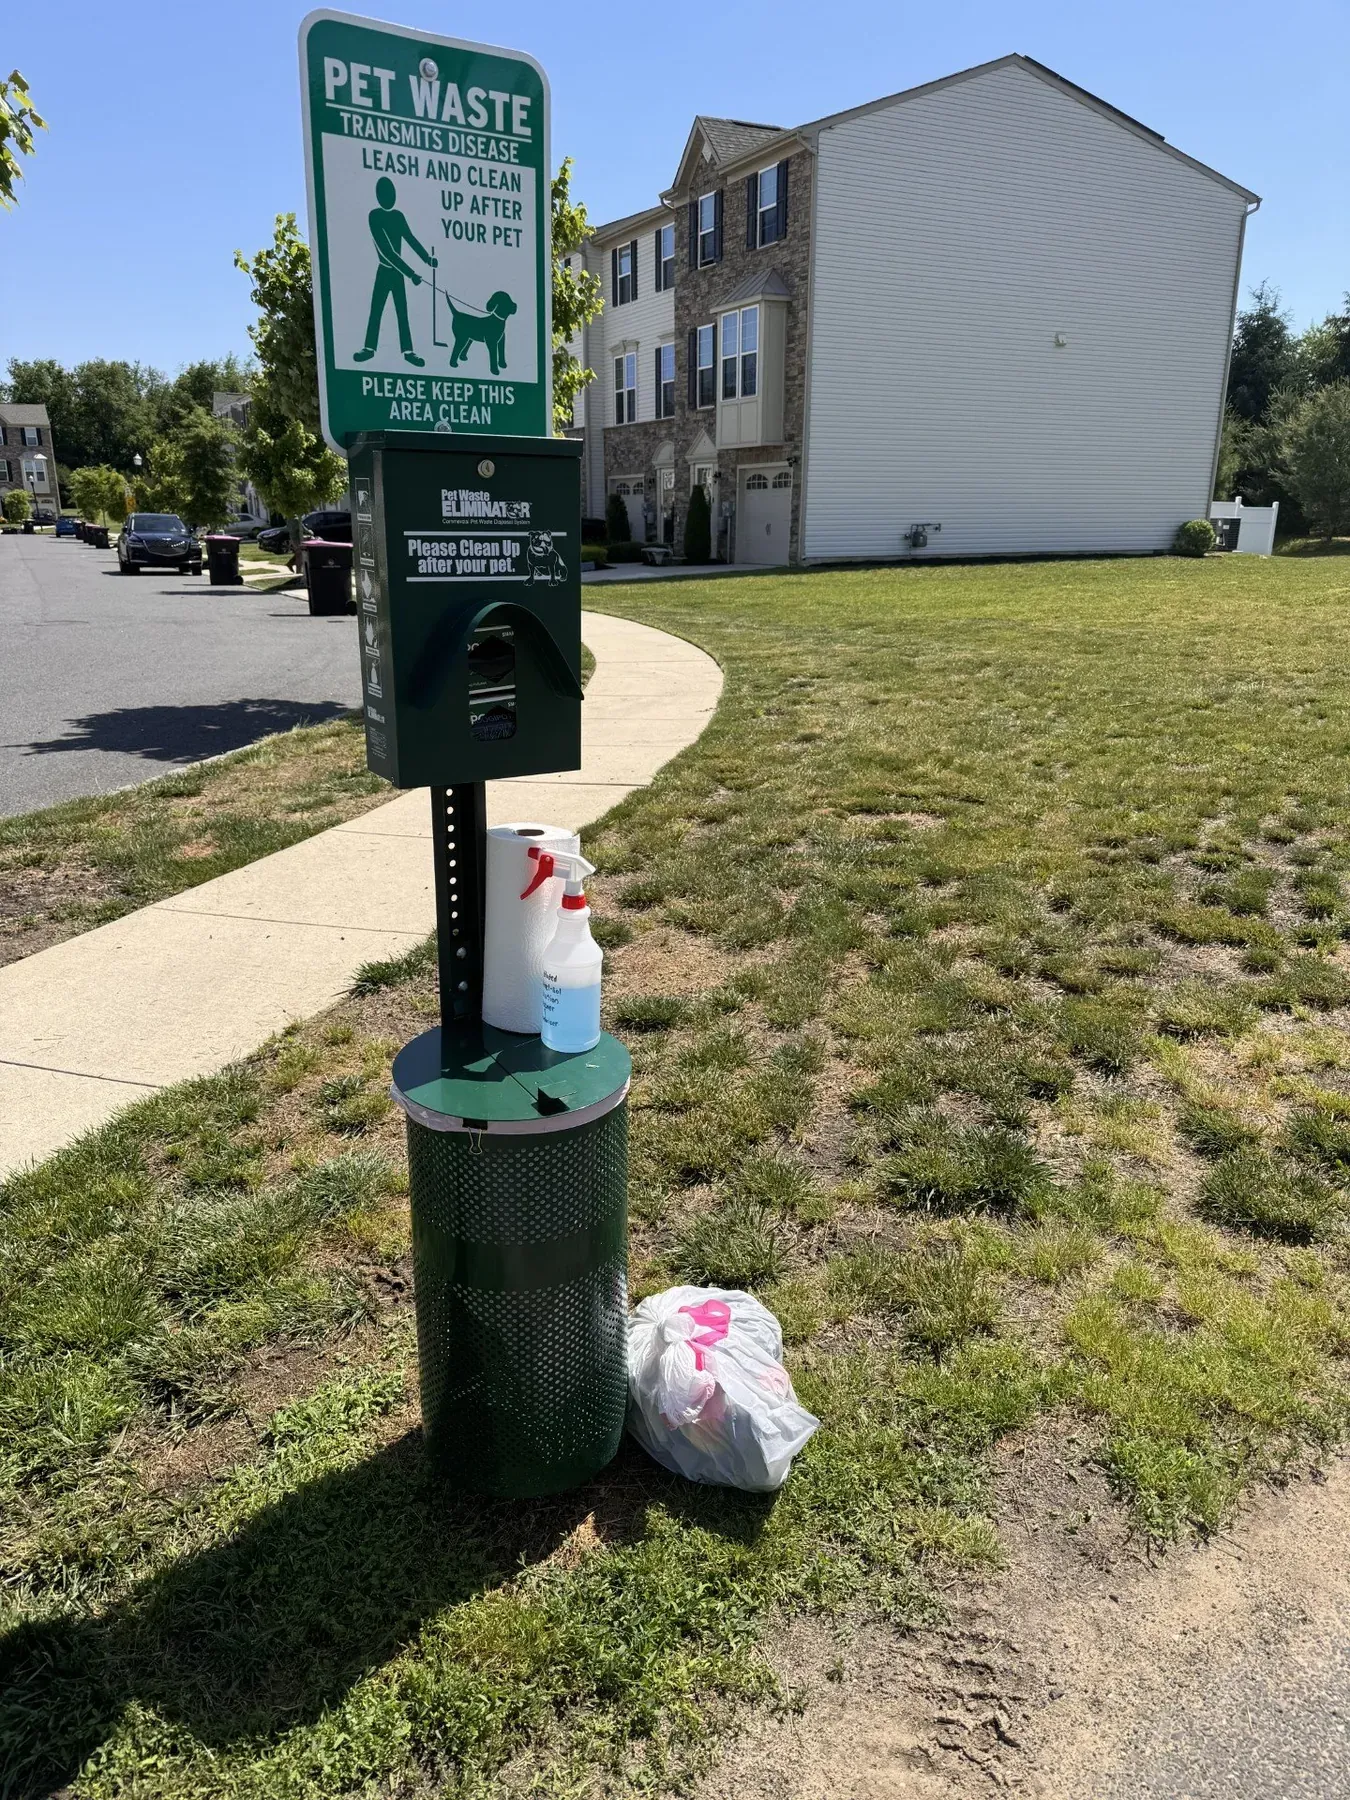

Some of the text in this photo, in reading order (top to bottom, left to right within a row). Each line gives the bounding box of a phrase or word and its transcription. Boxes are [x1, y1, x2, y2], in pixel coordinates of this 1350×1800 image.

[324, 56, 532, 136] PET WASTE
[340, 111, 519, 163] TRANSMITS DISEASE
[362, 147, 521, 193] LEASH AND CLEAN
[441, 190, 522, 221] UP AFTER
[441, 218, 522, 248] YOUR PET
[362, 376, 515, 405] PLEASE KEEP THIS
[389, 401, 492, 425] AREA CLEAN
[441, 488, 490, 501] Pet Waste
[408, 539, 521, 558] Please Clean Up
[418, 556, 516, 575] after your pet.
